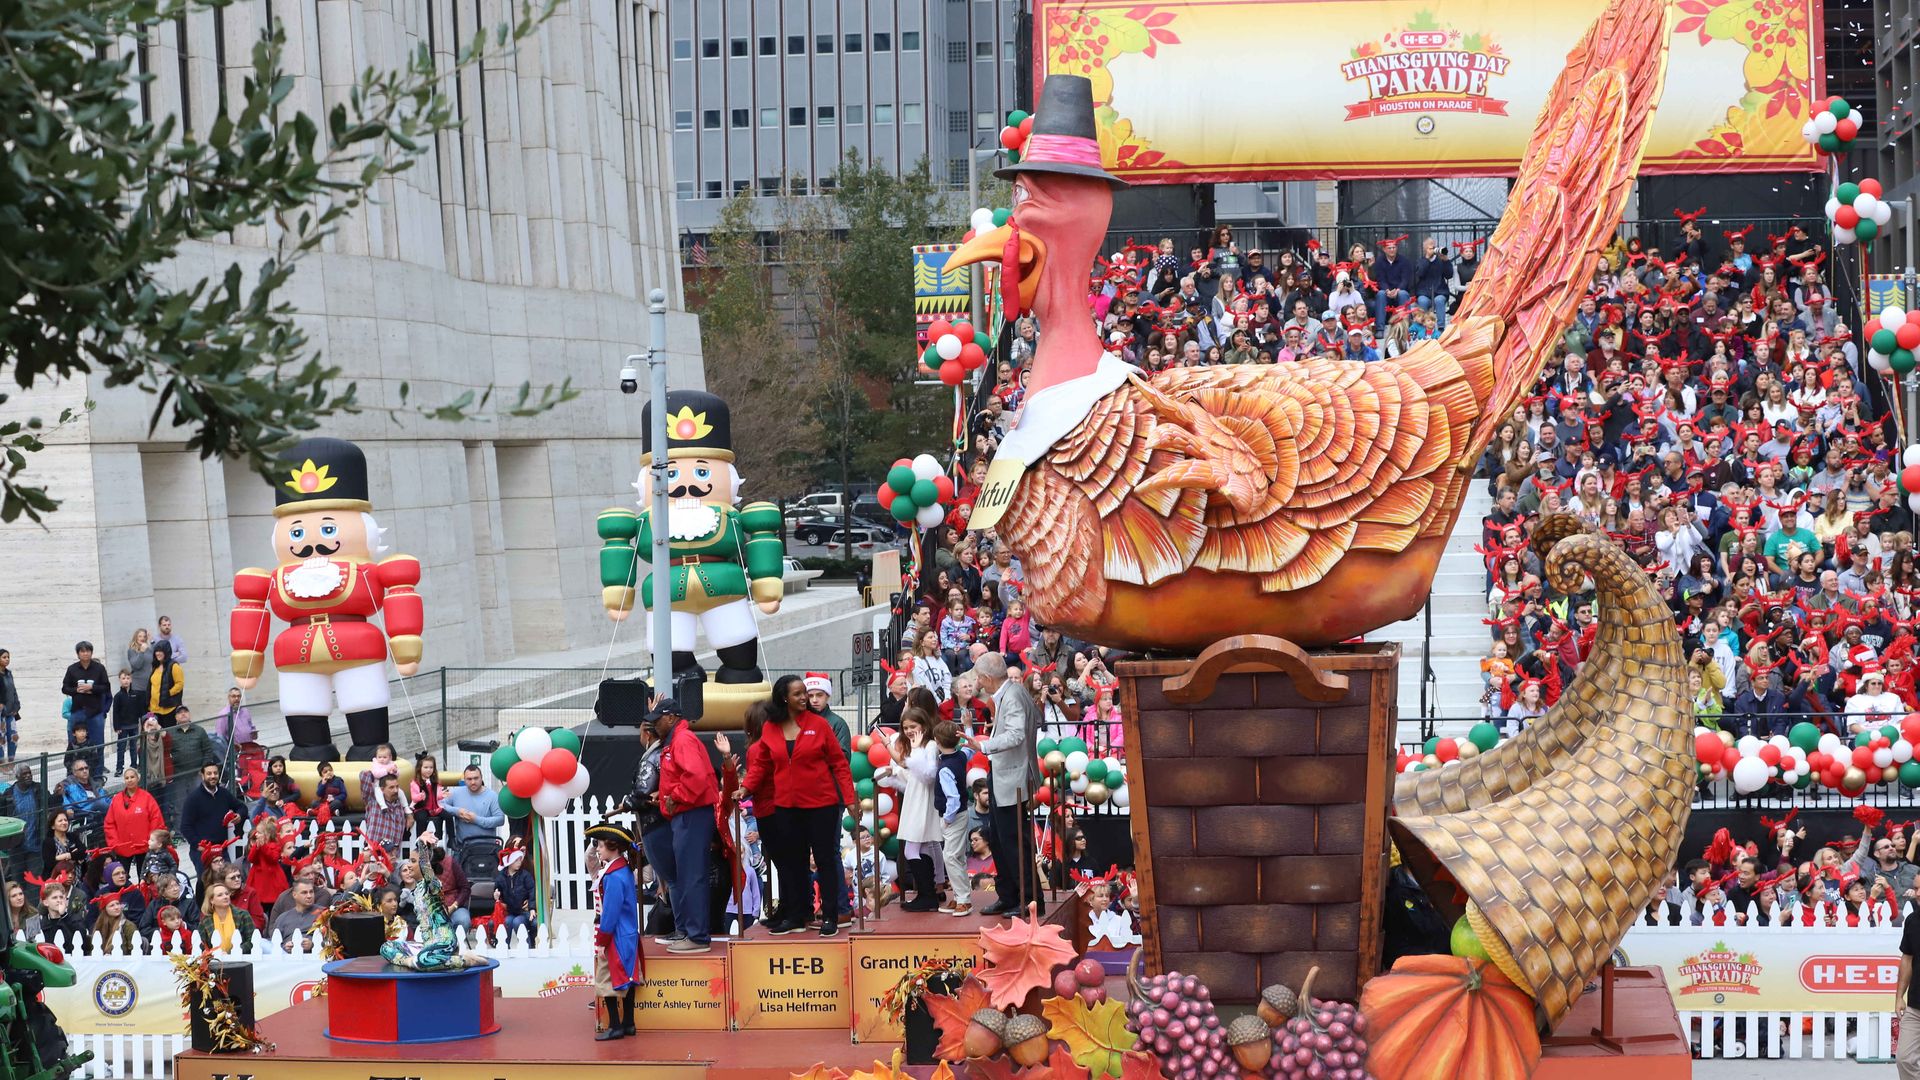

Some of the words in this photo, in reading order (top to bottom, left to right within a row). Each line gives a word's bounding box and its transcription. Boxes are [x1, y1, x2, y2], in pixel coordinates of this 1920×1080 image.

[1342, 52, 1470, 80] THANKSGIVING
[1473, 53, 1509, 74] DAY
[1368, 67, 1488, 99] PARADE
[1379, 101, 1421, 112] HOUSTON
[1423, 101, 1435, 109] ON
[1438, 101, 1473, 109] PARADE
[769, 957, 825, 975] H-E-B
[860, 955, 909, 969] Grand
[914, 955, 977, 969] Mshal
[1679, 963, 1742, 976] THANKSGIVING
[1744, 963, 1762, 975] DAY
[1812, 964, 1900, 984] H-E-B
[680, 978, 708, 987] Turner
[1691, 970, 1751, 985] PARADE
[657, 989, 664, 998] &
[757, 988, 794, 999] Winell
[796, 988, 838, 998] Herron
[633, 1000, 661, 1010] ughter
[663, 1000, 691, 1010] Ashley
[693, 1000, 722, 1009] Turner
[760, 1002, 783, 1013] Lisa
[786, 1002, 837, 1012] Helfman
